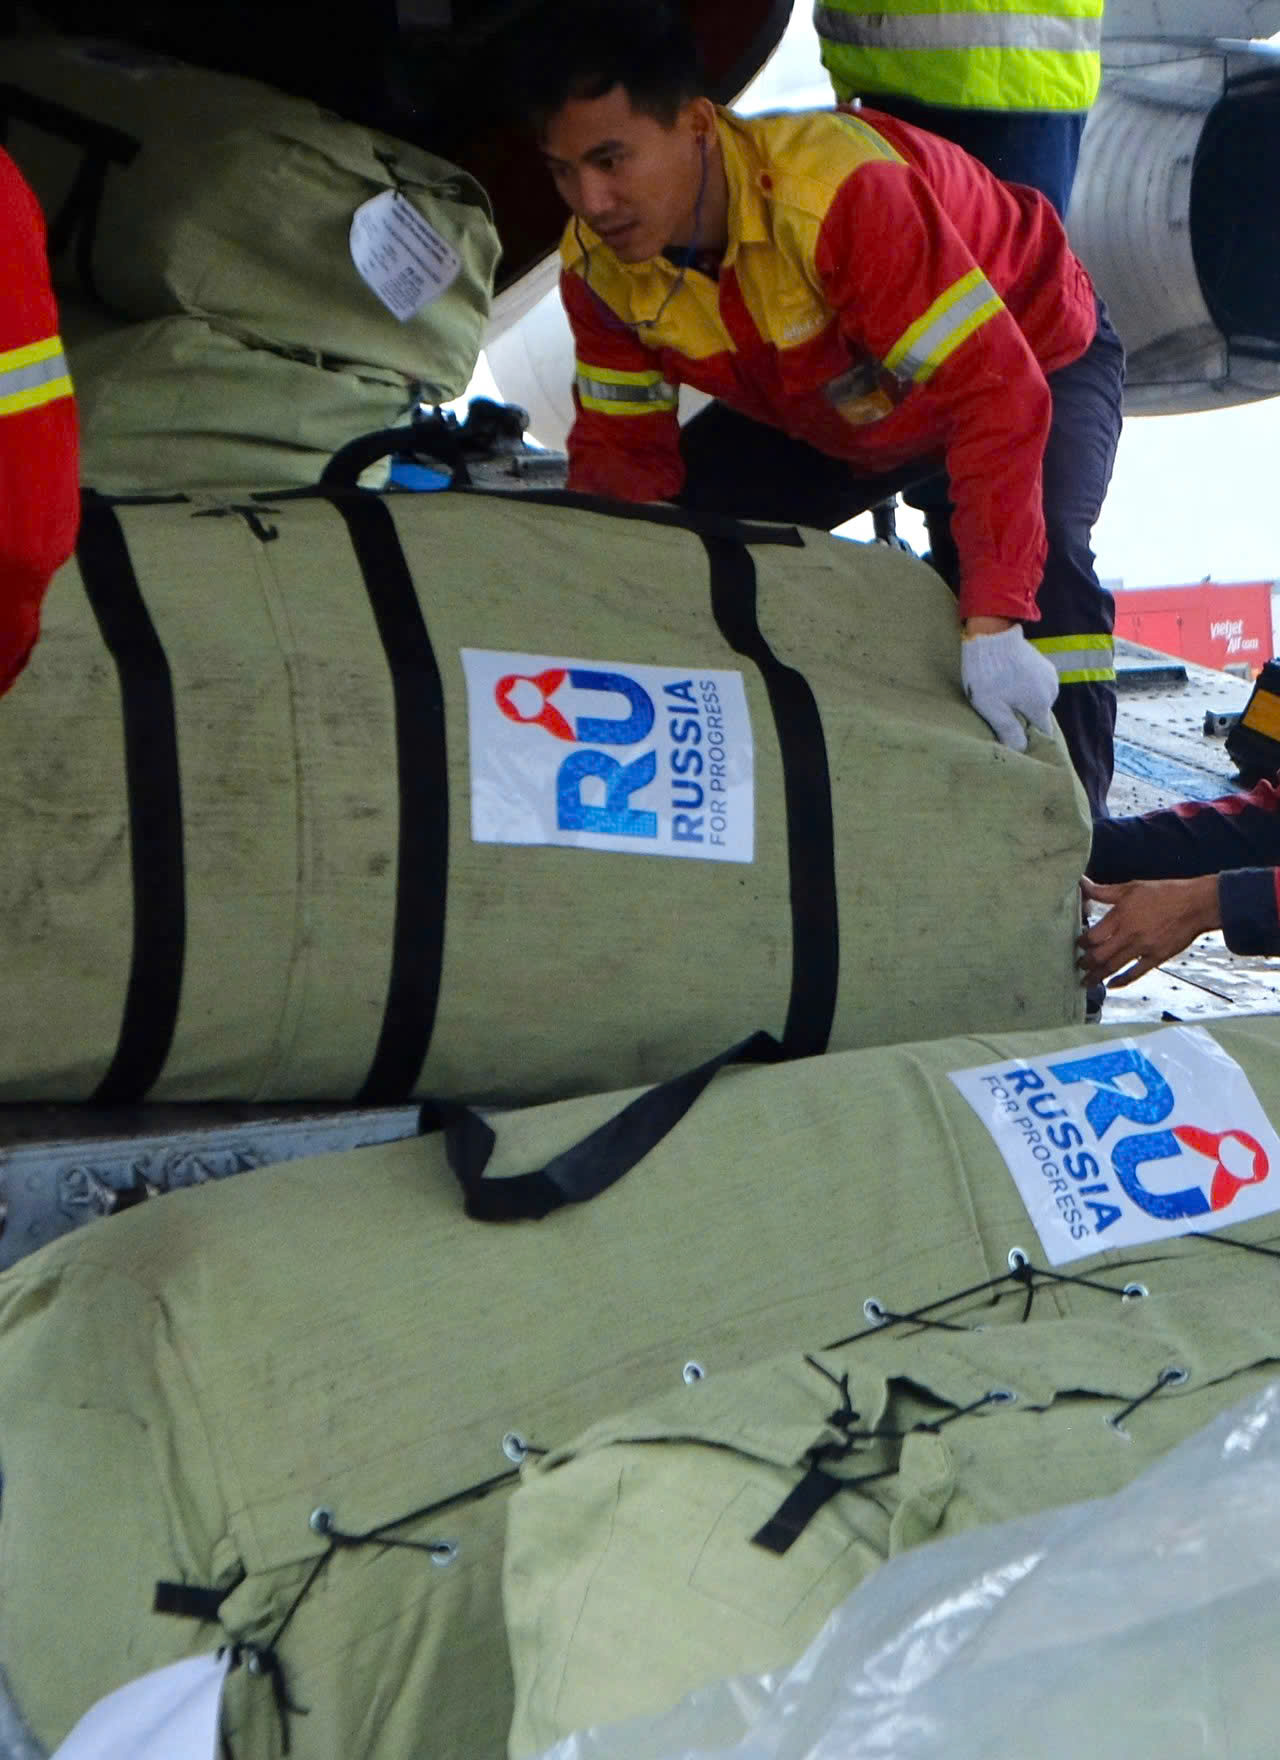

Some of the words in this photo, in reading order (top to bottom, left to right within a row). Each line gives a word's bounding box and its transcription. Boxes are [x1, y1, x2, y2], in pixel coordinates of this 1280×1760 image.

[556, 668, 658, 839] RU
[663, 680, 705, 842] RUSSIA
[700, 680, 727, 793] PROGRESS
[709, 800, 727, 847] FOR
[981, 1075, 1020, 1114] FOR
[1013, 1117, 1090, 1241] PROGRESS
[1003, 1068, 1123, 1234] RUSSIA
[1046, 1048, 1213, 1221] RU
